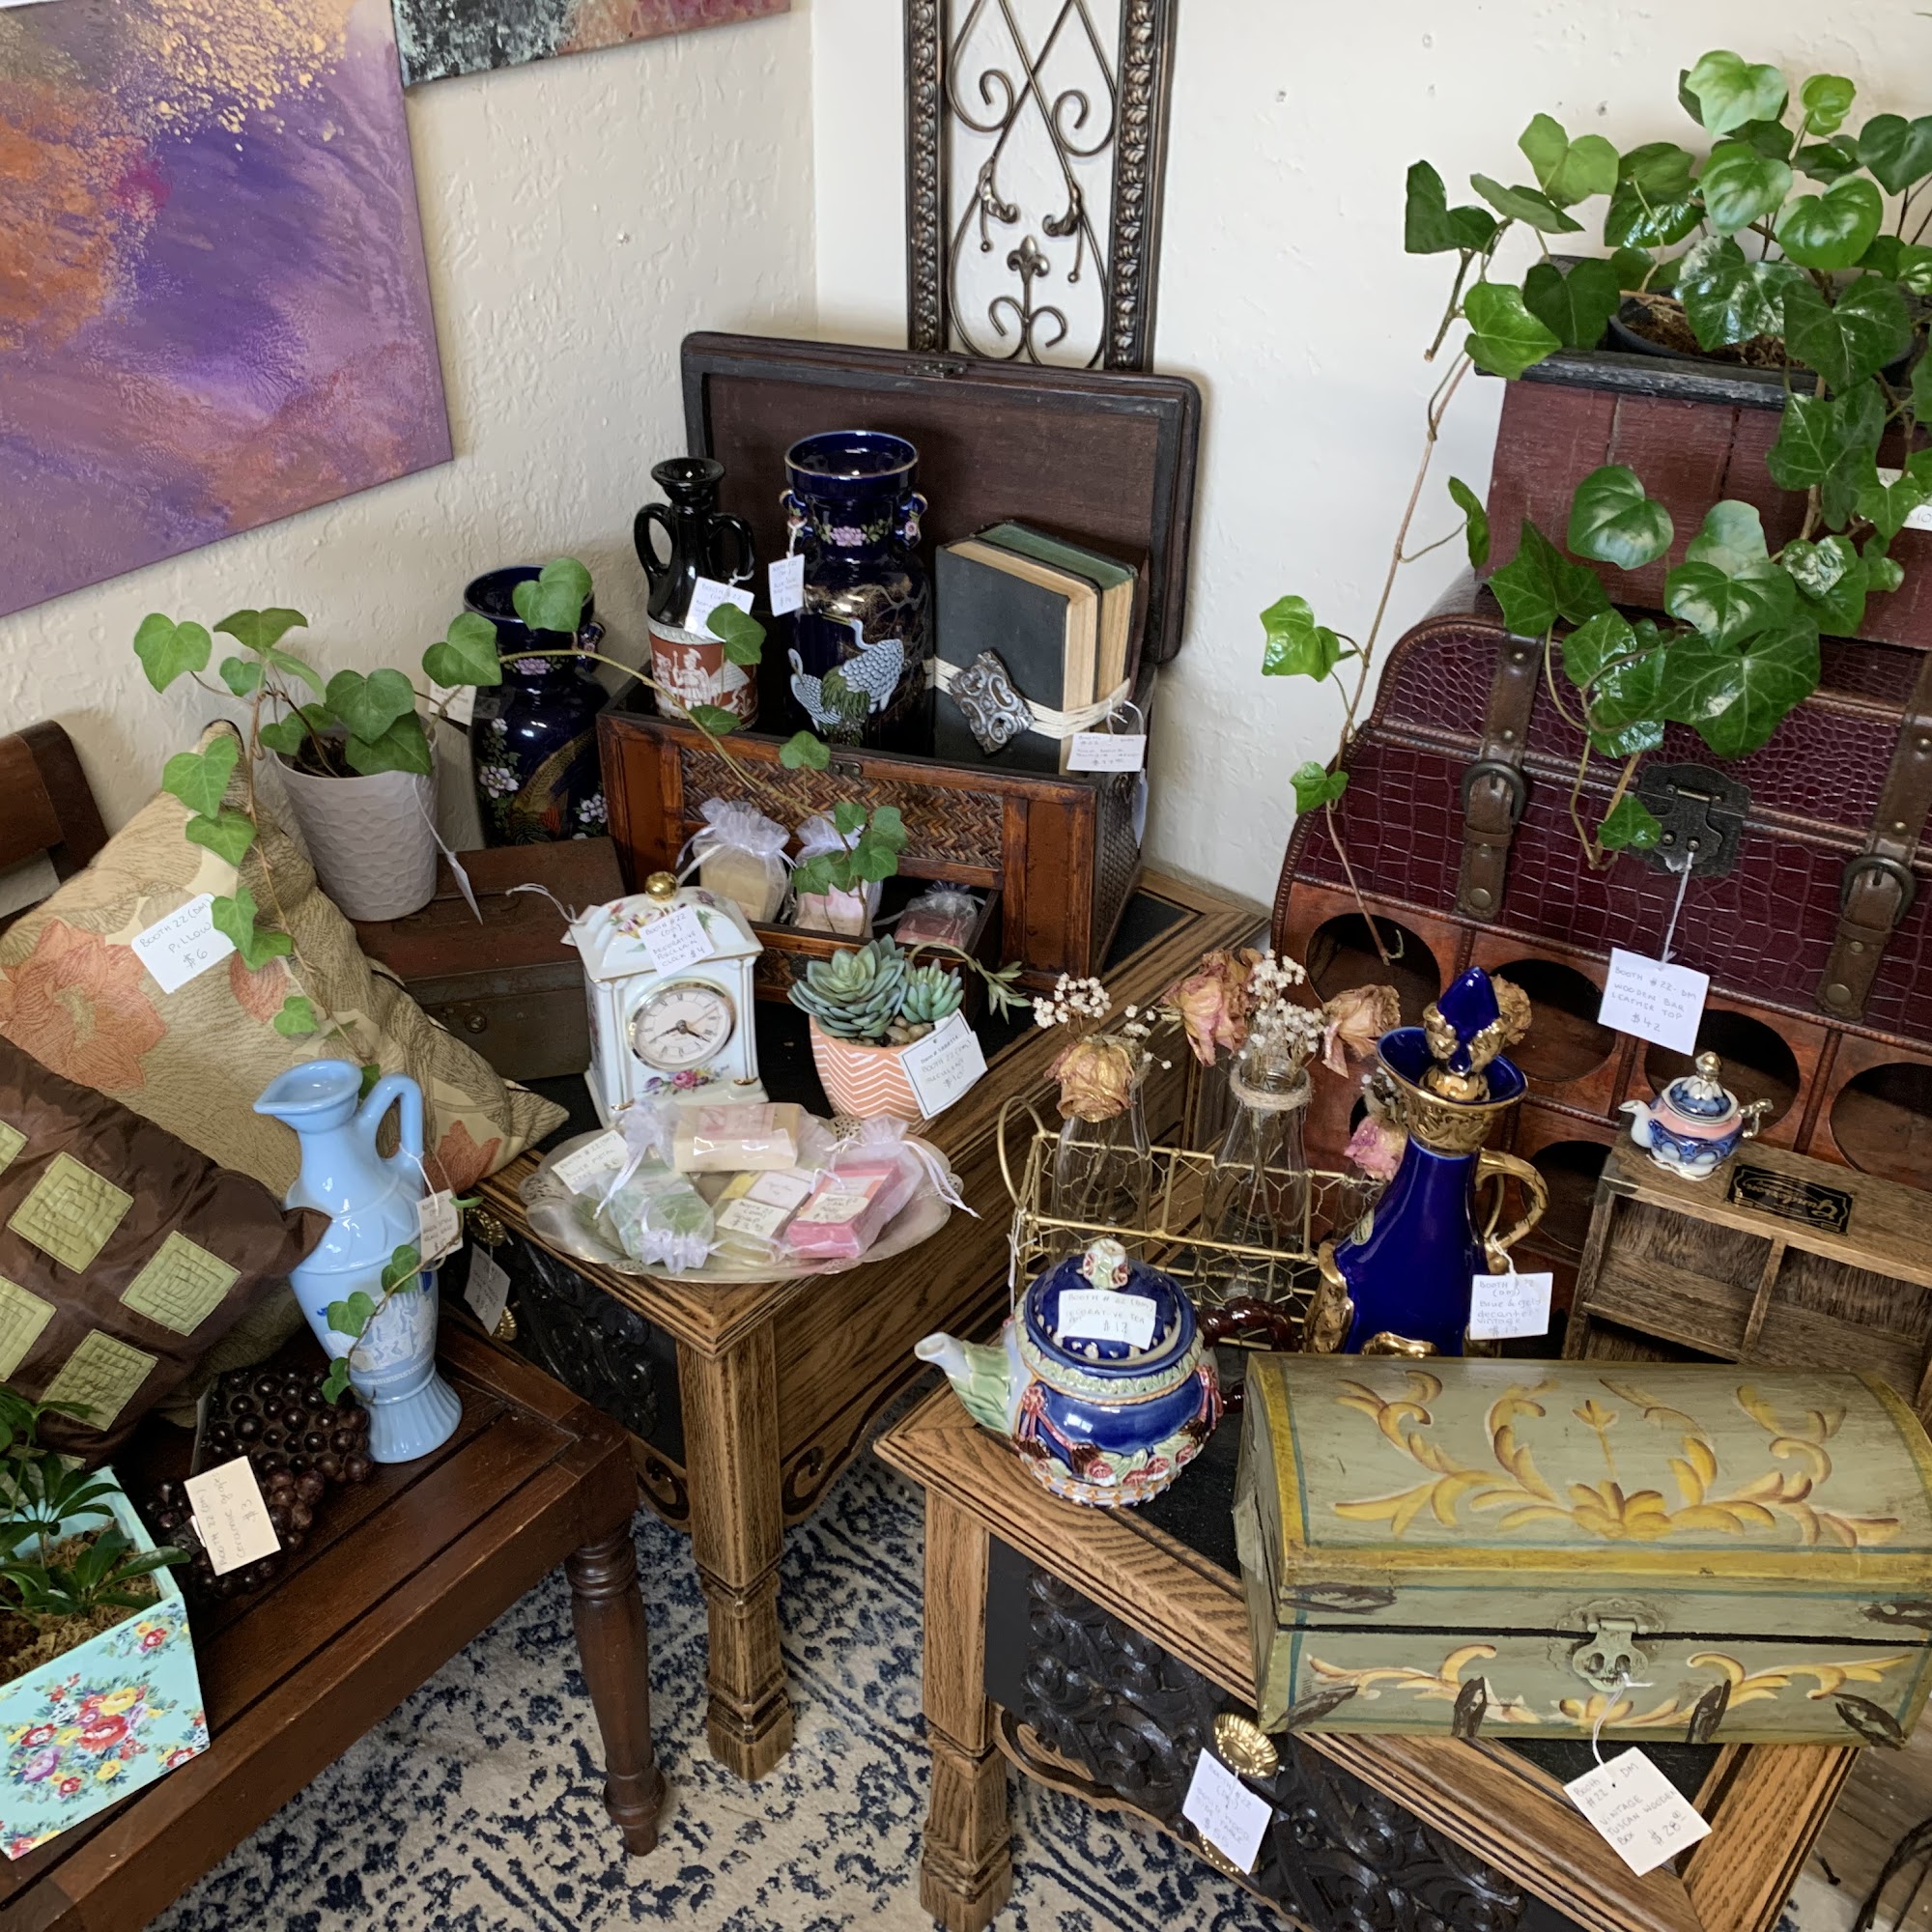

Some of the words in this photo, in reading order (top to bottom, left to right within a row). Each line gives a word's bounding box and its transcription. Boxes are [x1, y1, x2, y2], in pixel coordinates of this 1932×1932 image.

[139, 925, 172, 947] BOOTH
[172, 916, 189, 927] 22
[184, 949, 208, 969] $6
[1614, 983, 1656, 1002] WOODEN
[1663, 997, 1685, 1012] BAR
[1615, 966, 1642, 981] BOOTH
[1682, 989, 1696, 1001] DM
[1611, 992, 1654, 1011] LEATHER
[1662, 1009, 1683, 1020] TOP
[1631, 1012, 1661, 1032] $42
[206, 1516, 214, 1528] 22
[242, 1499, 259, 1522] $3
[211, 1532, 227, 1566] BOOTH
[1573, 1778, 1600, 1797] Booth
[1619, 1763, 1638, 1777] DM
[1586, 1789, 1608, 1808] #22
[1600, 1795, 1644, 1826] VINTAGE
[1606, 1814, 1640, 1836] TUSCAN
[1642, 1790, 1677, 1812] WOODEN
